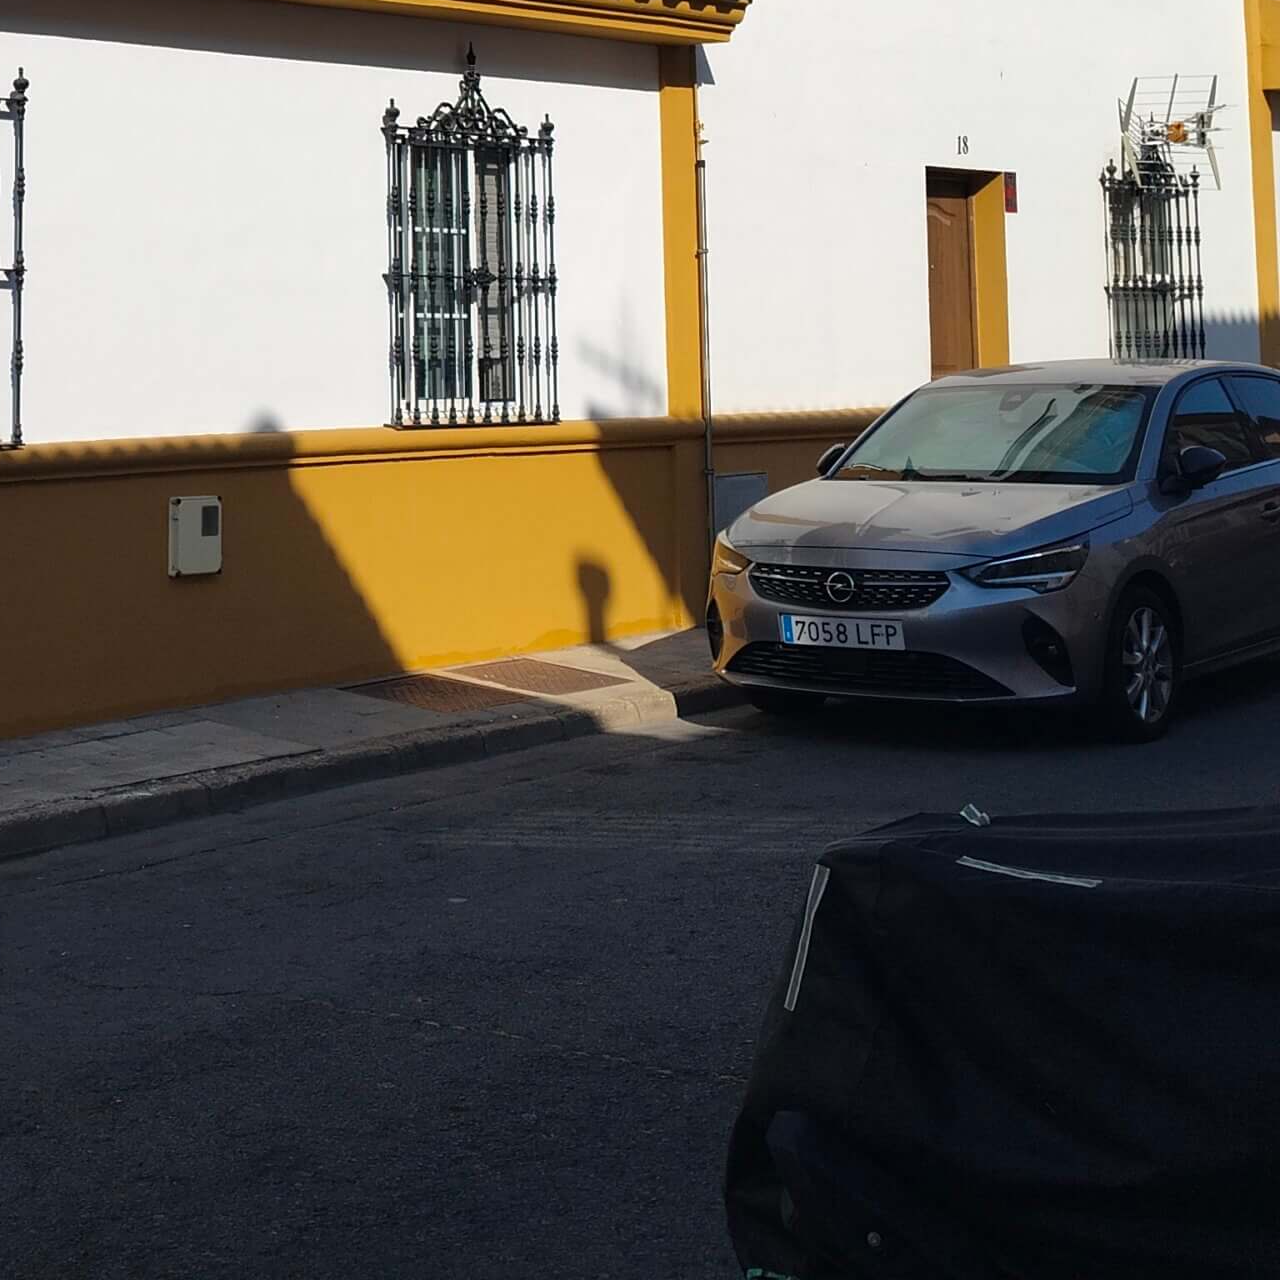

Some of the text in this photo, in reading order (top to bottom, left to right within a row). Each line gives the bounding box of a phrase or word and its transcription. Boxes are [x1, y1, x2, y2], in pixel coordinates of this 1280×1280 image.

[957, 135, 969, 155] 18
[795, 620, 897, 646] 7058 LFP
